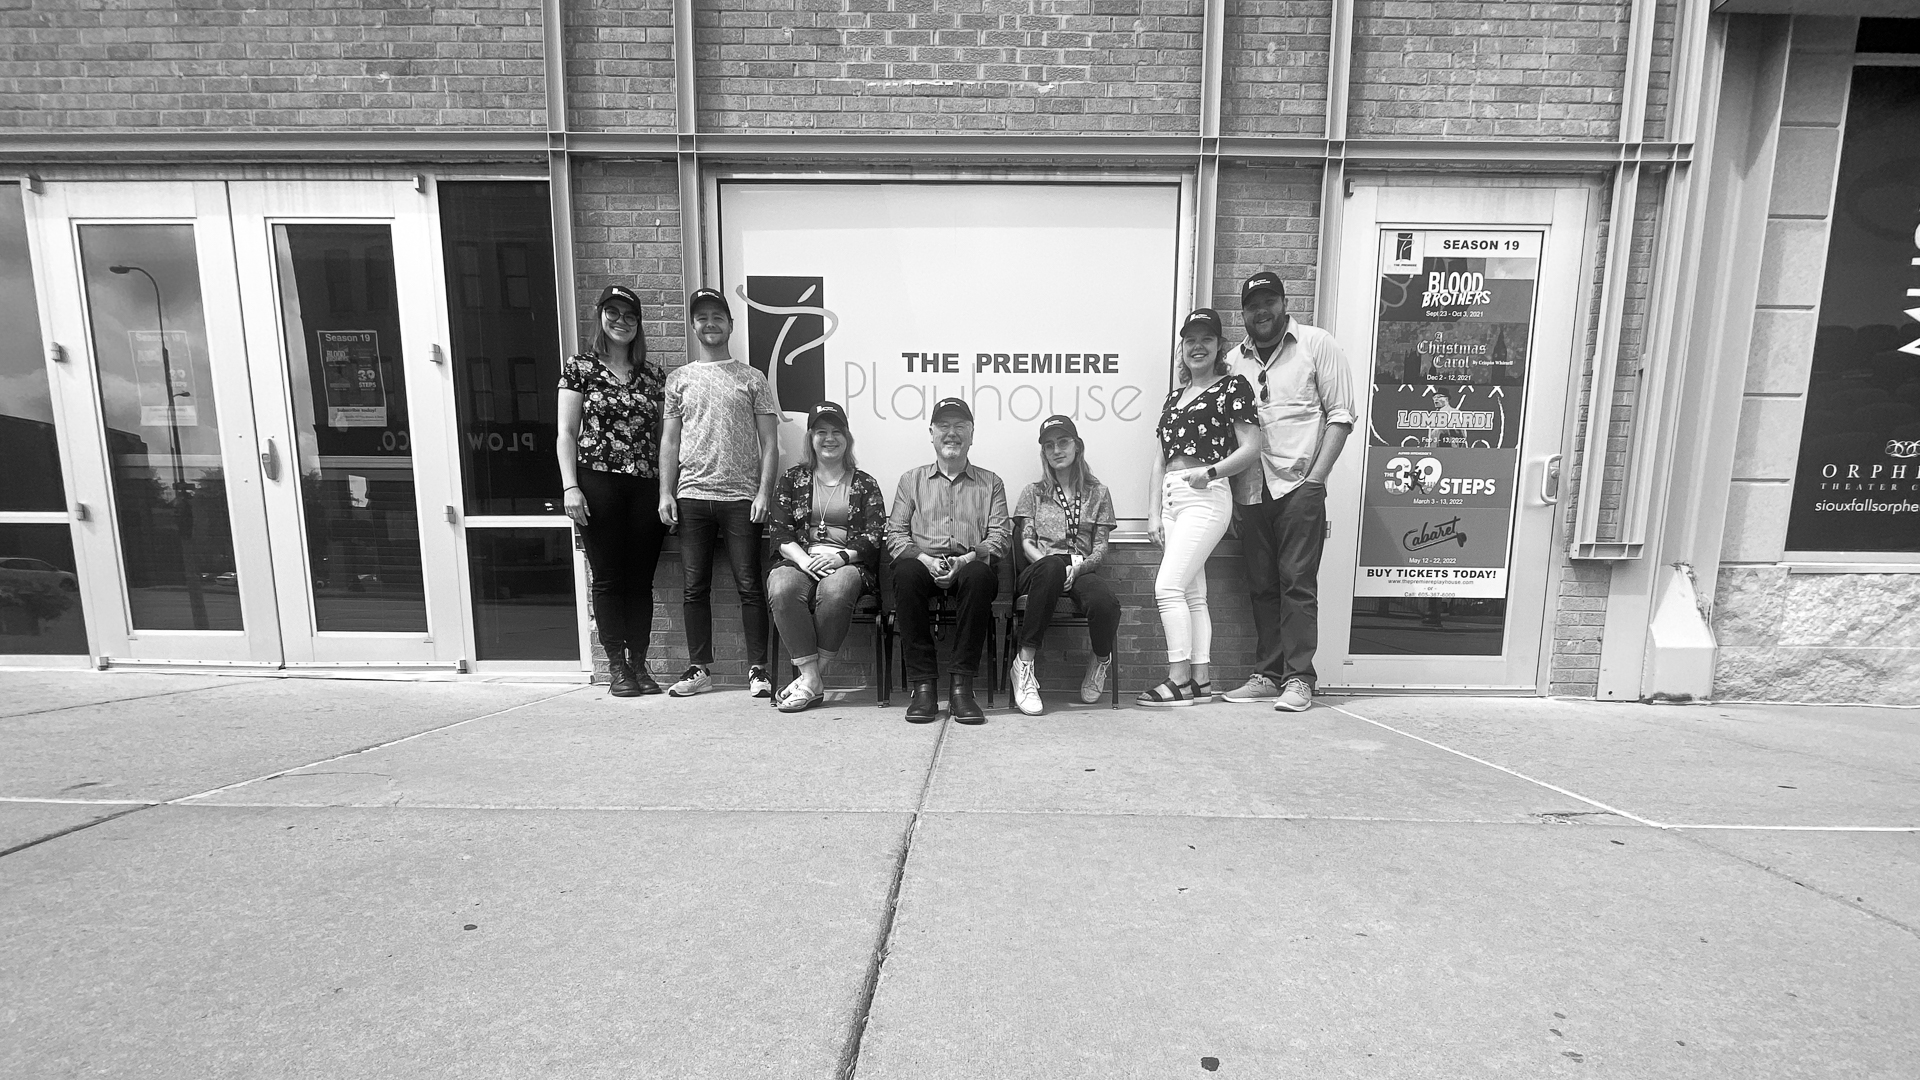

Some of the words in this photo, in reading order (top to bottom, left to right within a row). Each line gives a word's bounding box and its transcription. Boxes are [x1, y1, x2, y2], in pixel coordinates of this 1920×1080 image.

[1443, 239, 1498, 250] SEASON
[1504, 240, 1520, 251] 19
[1428, 271, 1484, 293] BLOOD
[1421, 290, 1492, 308] BROTHERS
[325, 334, 358, 342] Season
[360, 334, 371, 342] 19
[1434, 331, 1443, 342] A
[1417, 340, 1488, 355] Christmas
[901, 352, 960, 374] THE
[976, 353, 1119, 374] PREMIERE
[1433, 354, 1470, 368] Carol
[358, 370, 376, 381] 39
[844, 360, 1143, 422] Plahouse
[1397, 410, 1495, 430] LOMBARDI
[1384, 457, 1442, 495] 39
[1439, 478, 1496, 495] STEPS
[1820, 482, 1898, 491] THEATER
[1815, 498, 1920, 514] siouxfallsorphe
[1402, 516, 1460, 551] Cabaret
[1367, 568, 1392, 578] BUY
[1396, 569, 1448, 578] TICKETS
[1453, 570, 1497, 579] TODAY!
